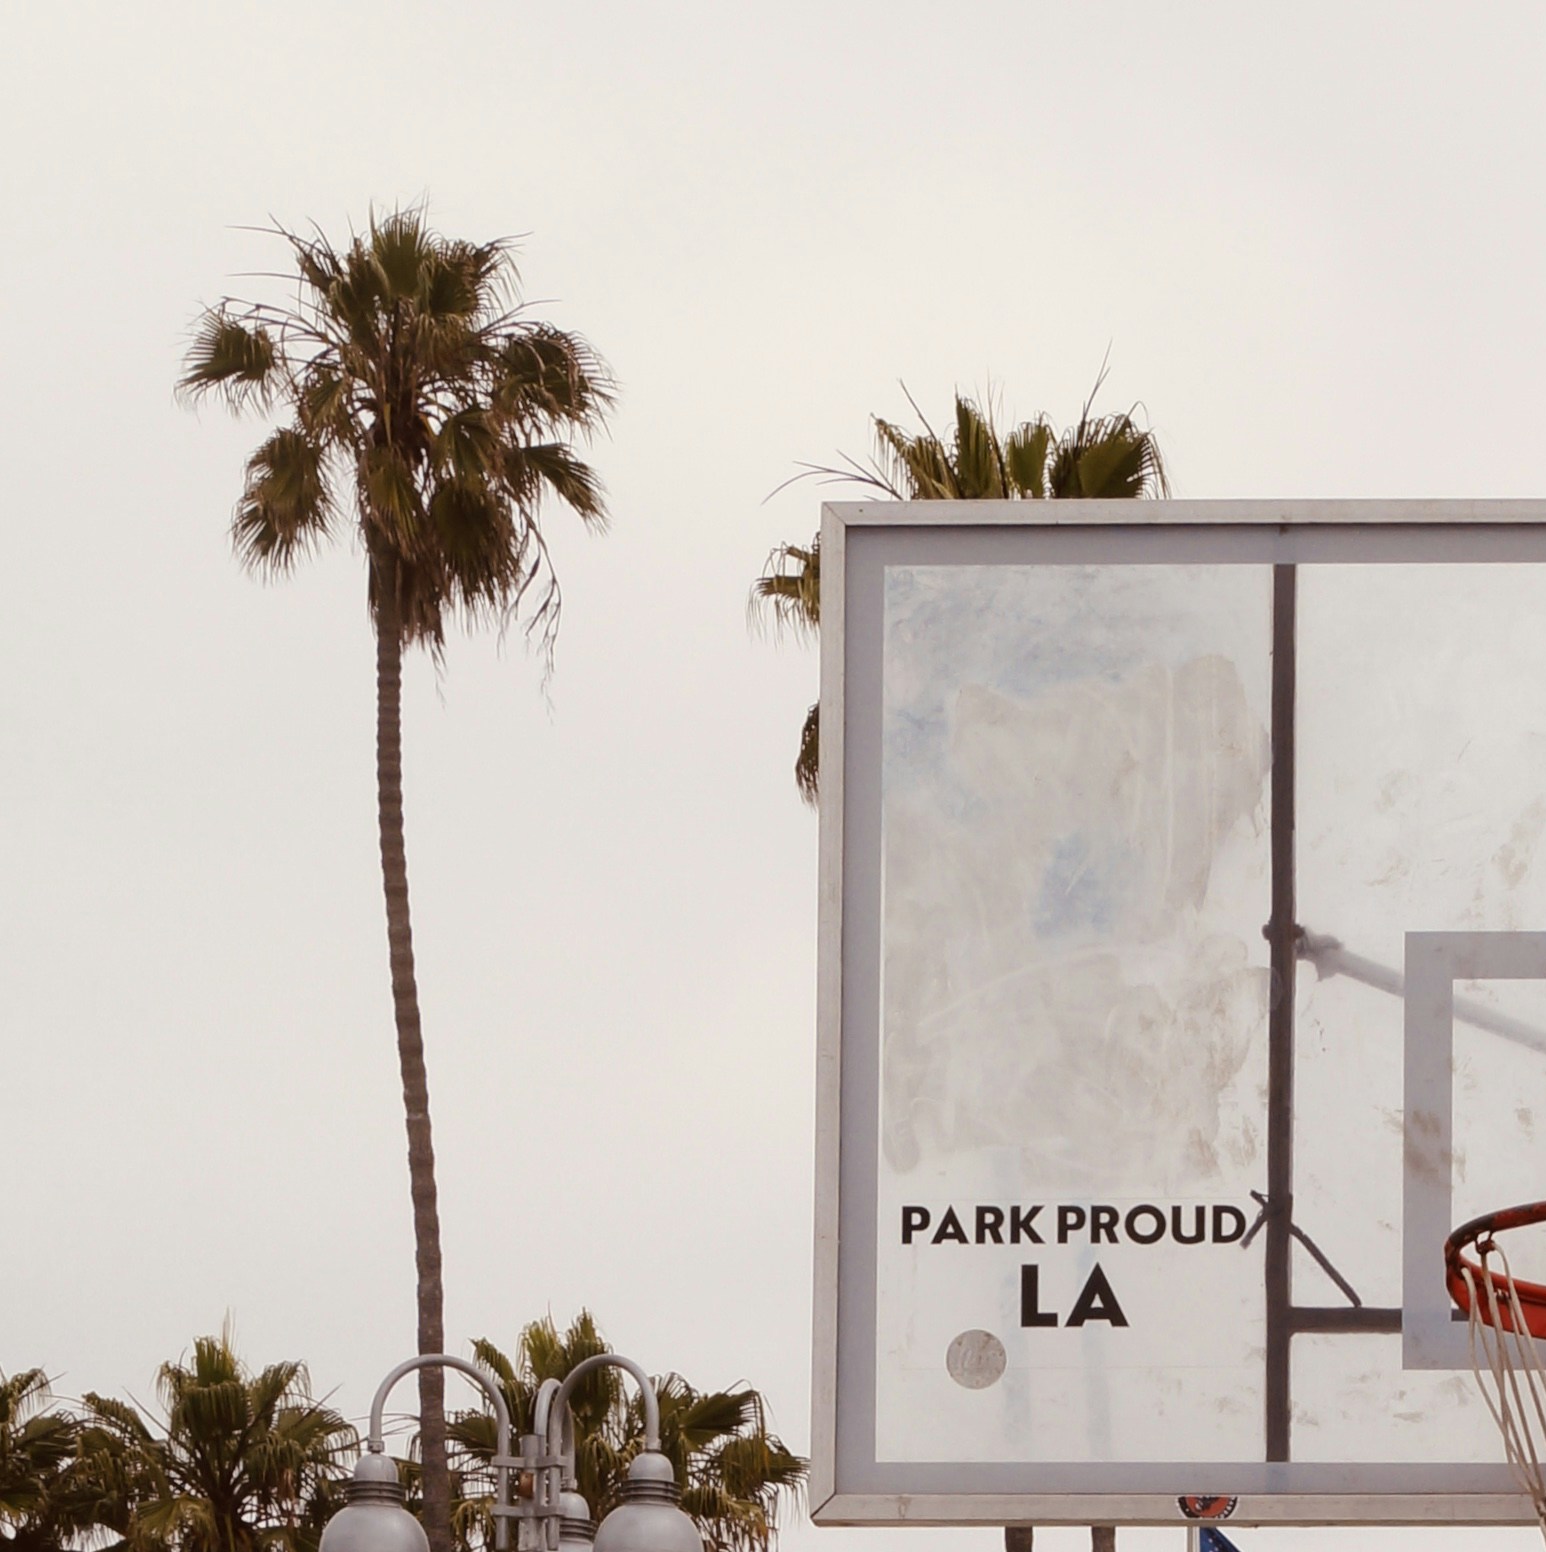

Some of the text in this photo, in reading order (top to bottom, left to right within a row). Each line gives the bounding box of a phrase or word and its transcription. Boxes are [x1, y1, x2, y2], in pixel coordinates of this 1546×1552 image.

[902, 1204, 1246, 1244] PARK PROUD
[1021, 1262, 1129, 1327] LA
